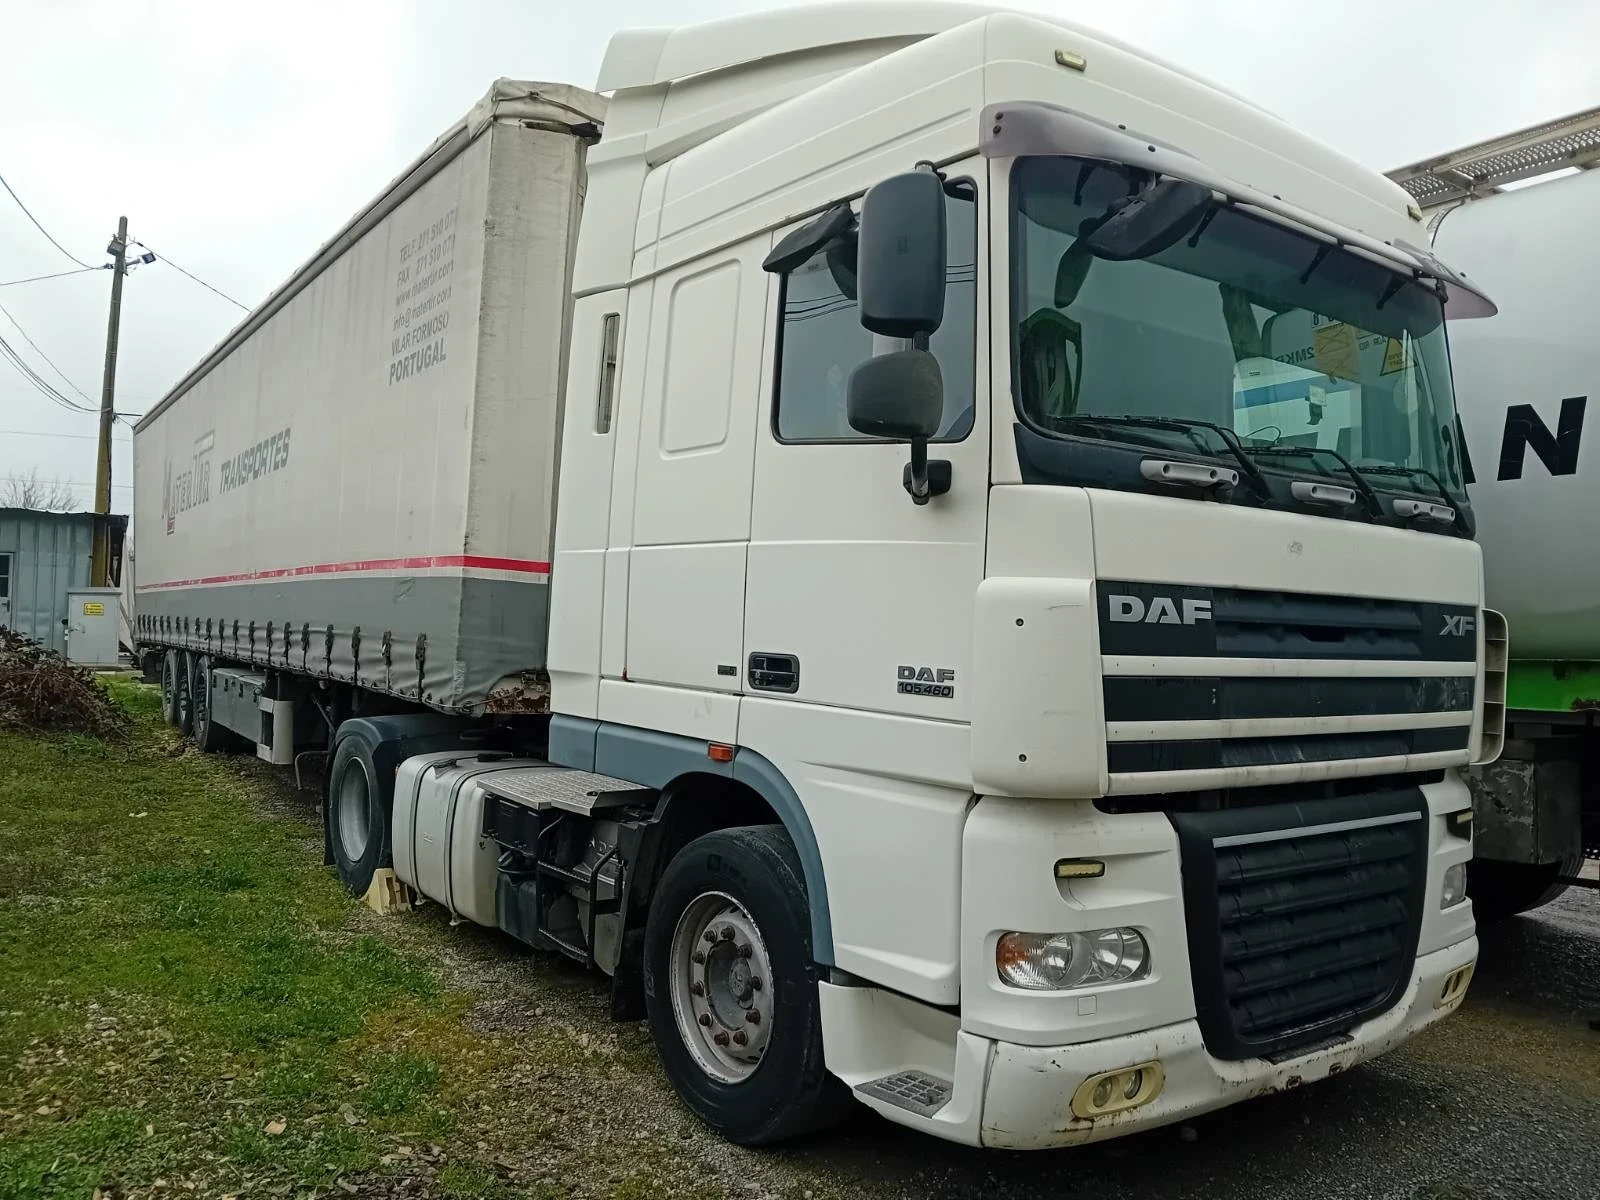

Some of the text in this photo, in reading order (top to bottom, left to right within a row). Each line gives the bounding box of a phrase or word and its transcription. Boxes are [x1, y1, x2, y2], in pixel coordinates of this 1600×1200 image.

[397, 266, 411, 288] FAX
[391, 311, 450, 357] VILAR FORMOSO
[389, 337, 447, 385] PORTUGAL
[219, 427, 291, 495] TRANSPORTES
[1108, 594, 1212, 625] DAF
[1439, 614, 1475, 636] XF
[897, 665, 955, 683] DAF
[898, 681, 953, 698] 105.460
